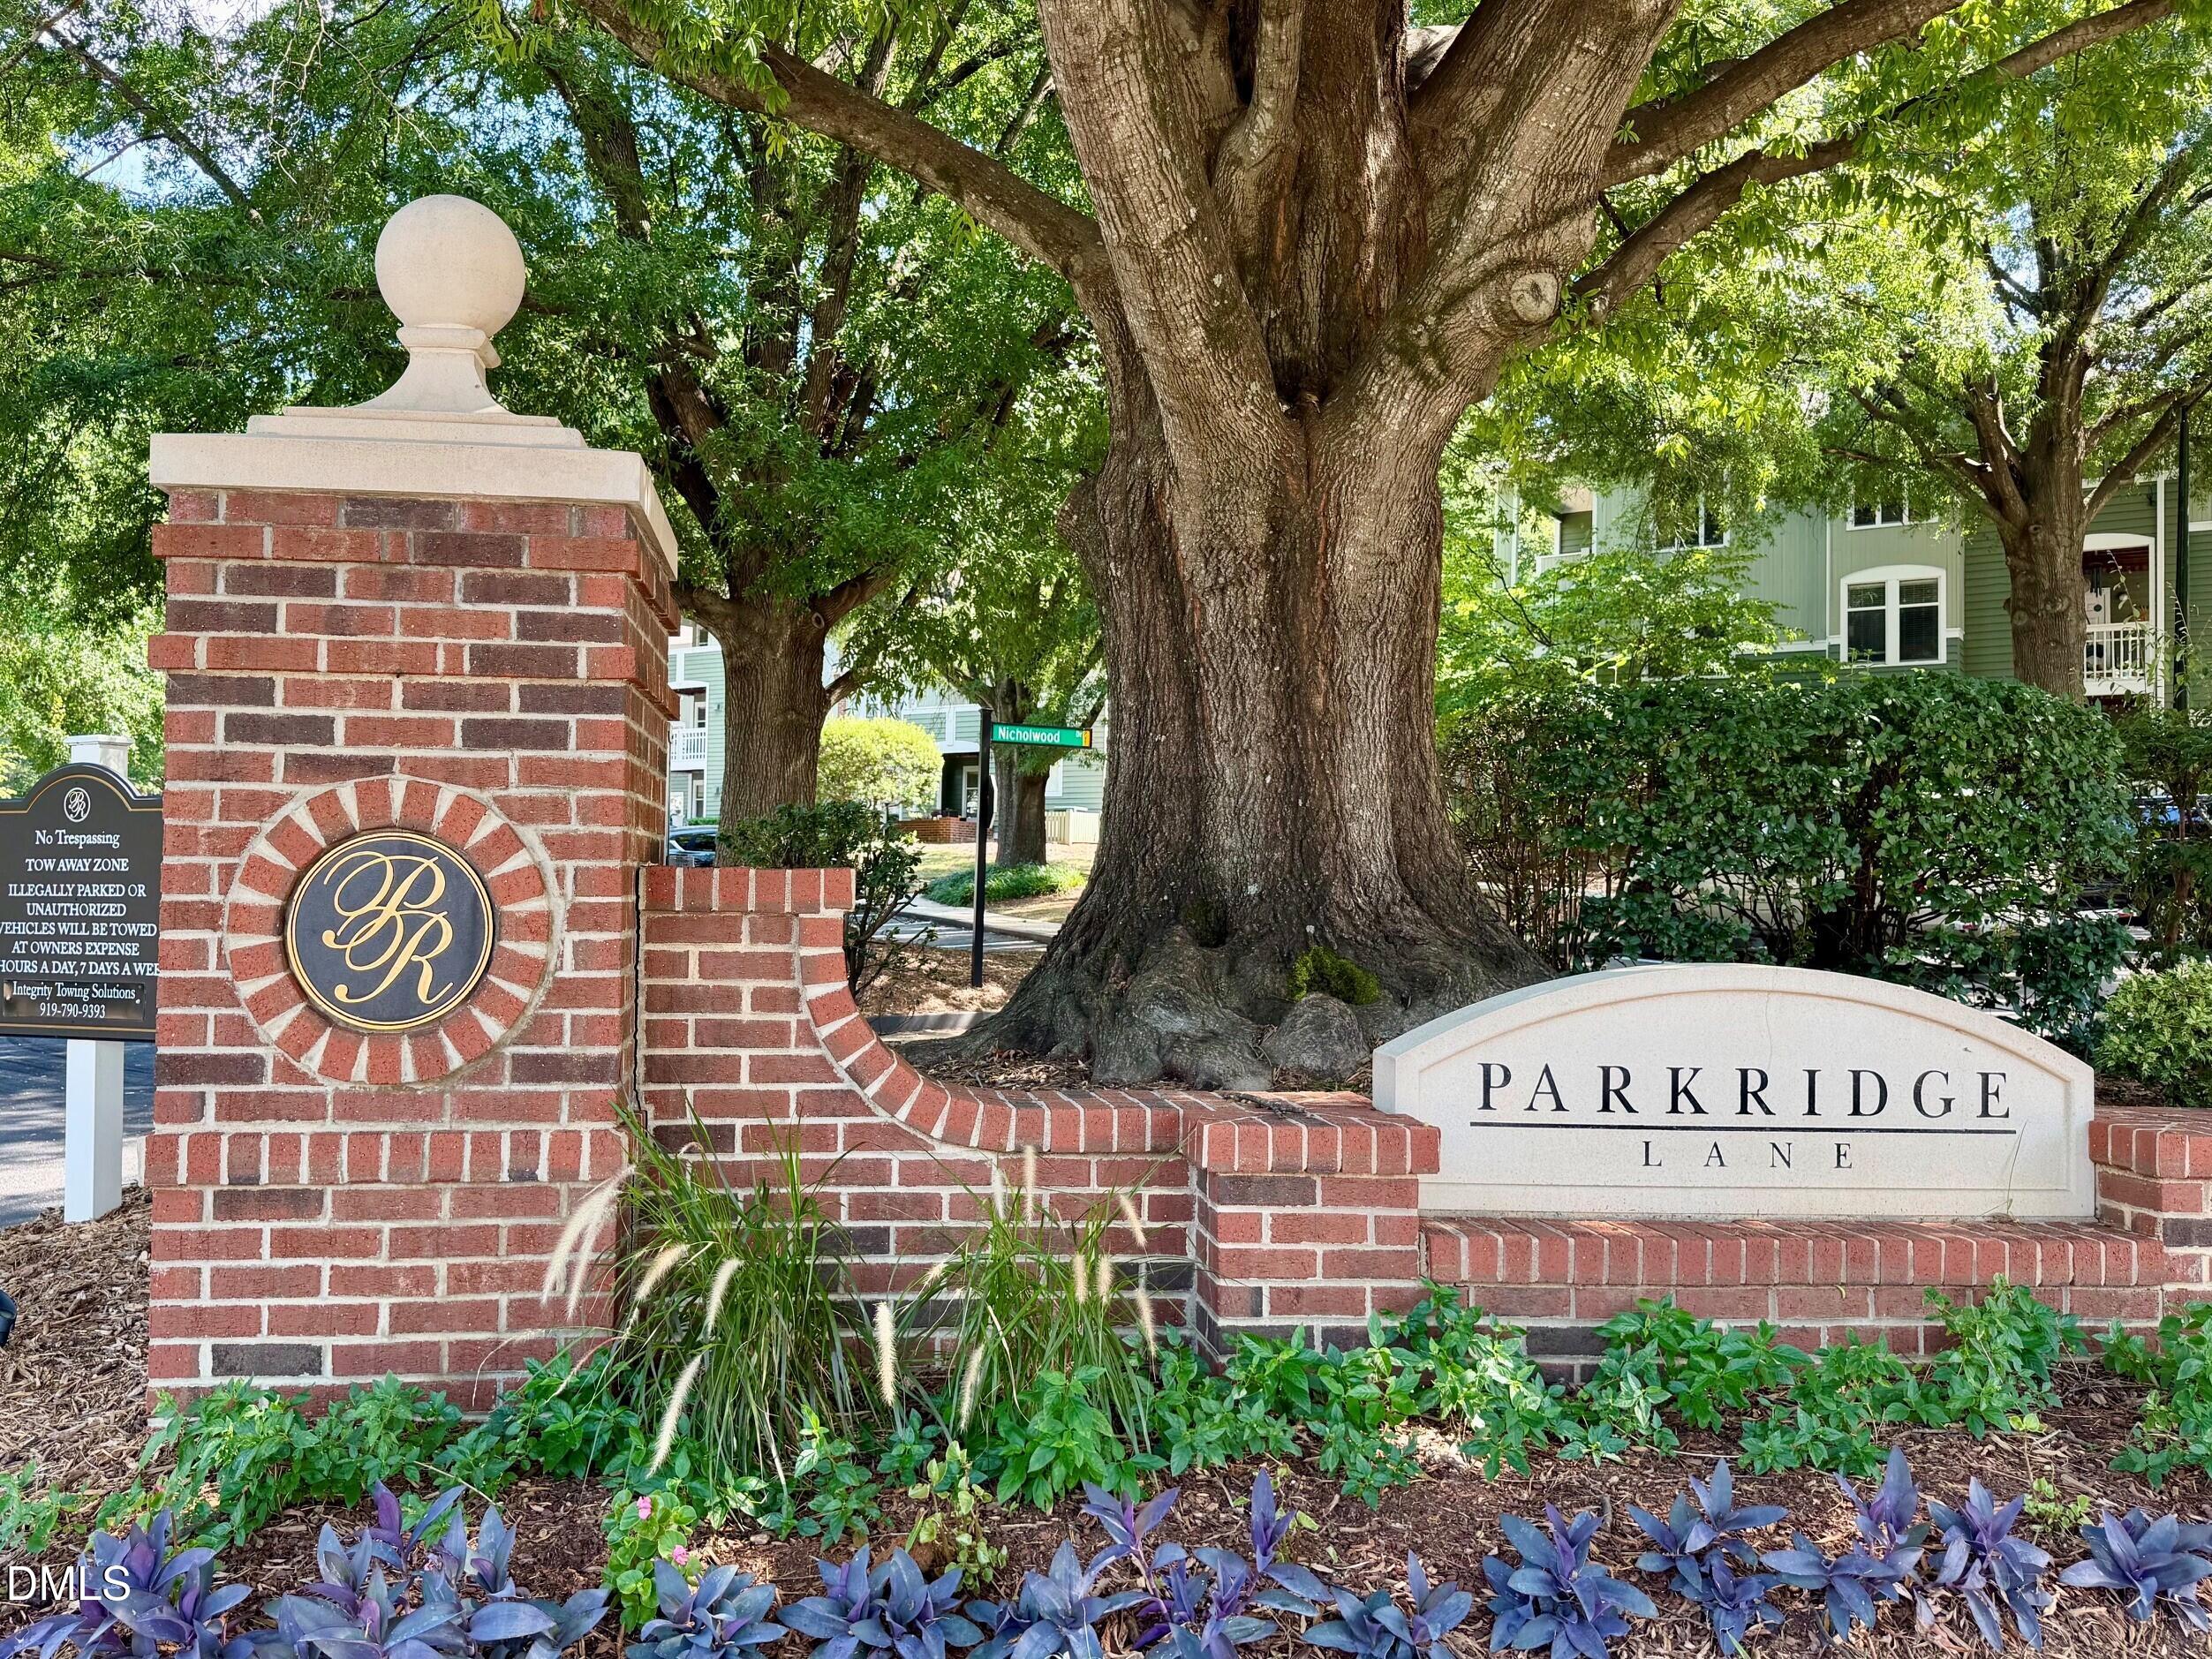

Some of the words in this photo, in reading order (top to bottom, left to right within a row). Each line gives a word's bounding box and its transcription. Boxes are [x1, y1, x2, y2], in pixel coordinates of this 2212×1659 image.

[998, 727, 1061, 743] Nicholwood
[35, 830, 52, 845] No
[55, 829, 120, 848] Trespassing
[26, 858, 56, 871] TOW
[57, 858, 92, 871] AWAY
[93, 858, 129, 871] ZONE
[8, 884, 75, 897] ILLEGALLY
[77, 884, 125, 897] PARKED
[128, 884, 147, 897] OR
[26, 902, 126, 916] UNAUTHORIZED
[57, 923, 89, 935] WILL
[92, 923, 108, 935] BE
[109, 923, 157, 937] TOWED
[11, 940, 28, 954] AT
[30, 941, 82, 954] OWNERS
[85, 942, 140, 956] EXPENSE
[40, 961, 49, 974] A
[51, 961, 78, 977] DAY,
[80, 961, 87, 974] 7
[88, 961, 119, 976] DAYS
[121, 962, 132, 976] A
[132, 962, 160, 977] WEE
[12, 981, 52, 999] Integrity
[55, 982, 89, 1001] Towing
[91, 984, 136, 999] Solutions
[40, 1002, 106, 1019] 919-790-9393
[1476, 1062, 2011, 1119] PARKRIDGE
[1642, 1141, 1853, 1169] LANE
